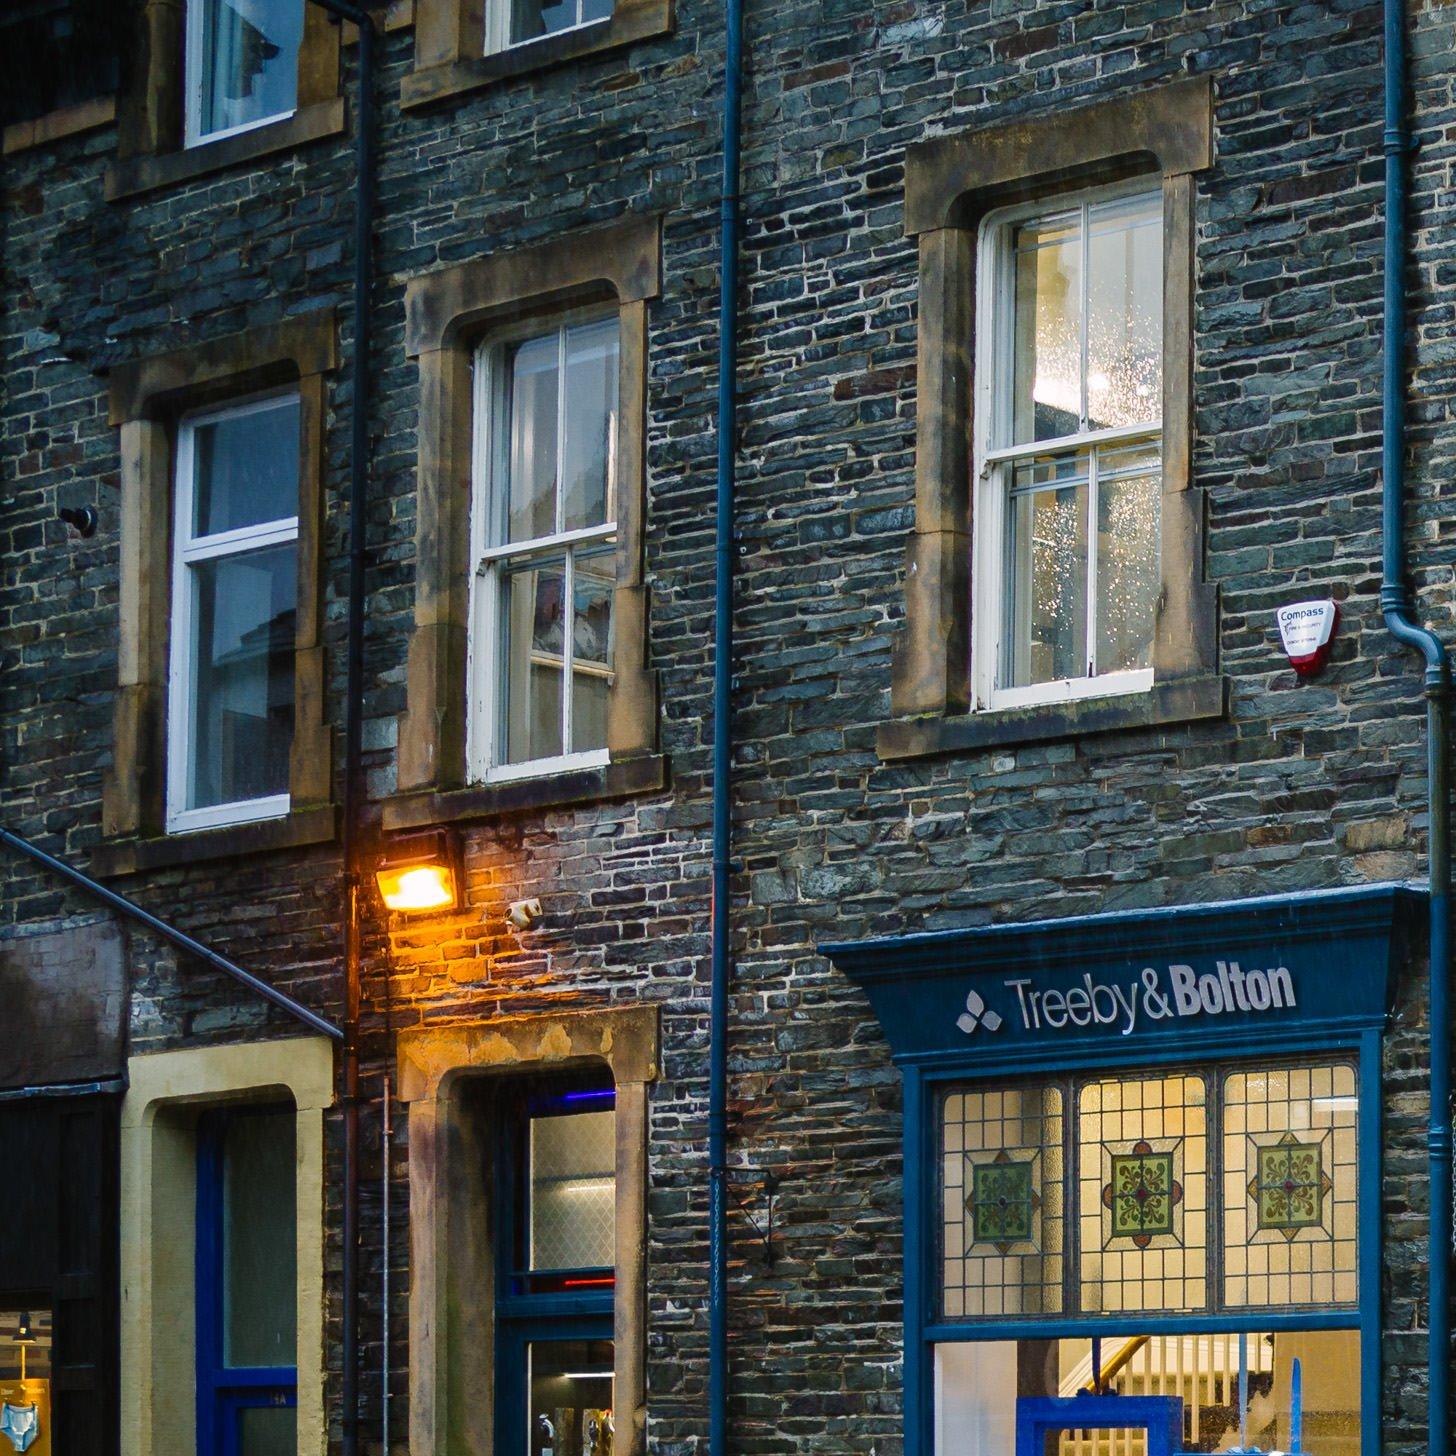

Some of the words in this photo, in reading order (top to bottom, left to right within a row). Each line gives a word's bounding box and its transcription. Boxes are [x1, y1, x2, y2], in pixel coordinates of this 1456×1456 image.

[1281, 608, 1324, 620] Compass
[1004, 972, 1138, 1036] Treeby
[1141, 967, 1175, 1020] &
[1169, 961, 1297, 1016] Bolton
